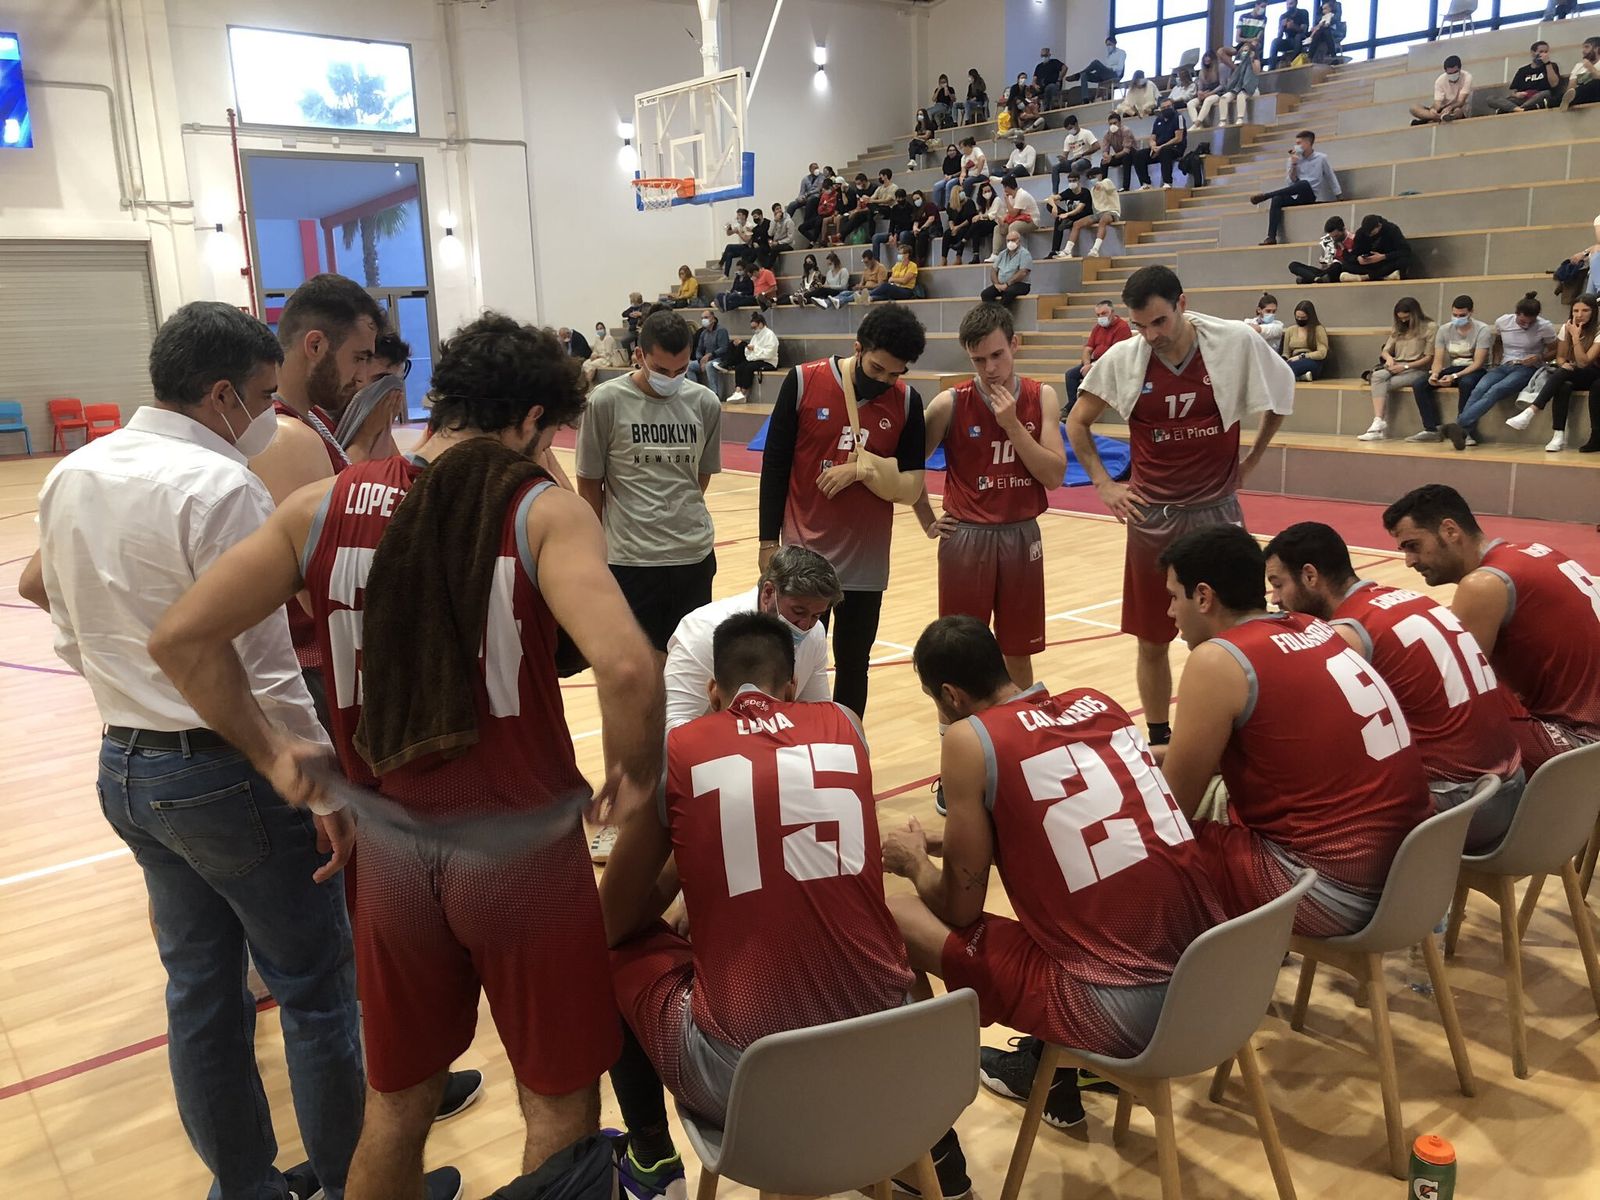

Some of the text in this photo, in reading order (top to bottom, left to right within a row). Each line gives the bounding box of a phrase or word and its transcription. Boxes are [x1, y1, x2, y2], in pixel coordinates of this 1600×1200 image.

[1525, 73, 1544, 82] FILA
[1164, 391, 1197, 419] 17
[631, 423, 697, 444] BROOKLYN
[1187, 426, 1219, 439] Pinar
[634, 455, 663, 463] NEW
[991, 440, 1016, 465] 10
[1326, 647, 1411, 762] 9
[691, 742, 865, 898] 15
